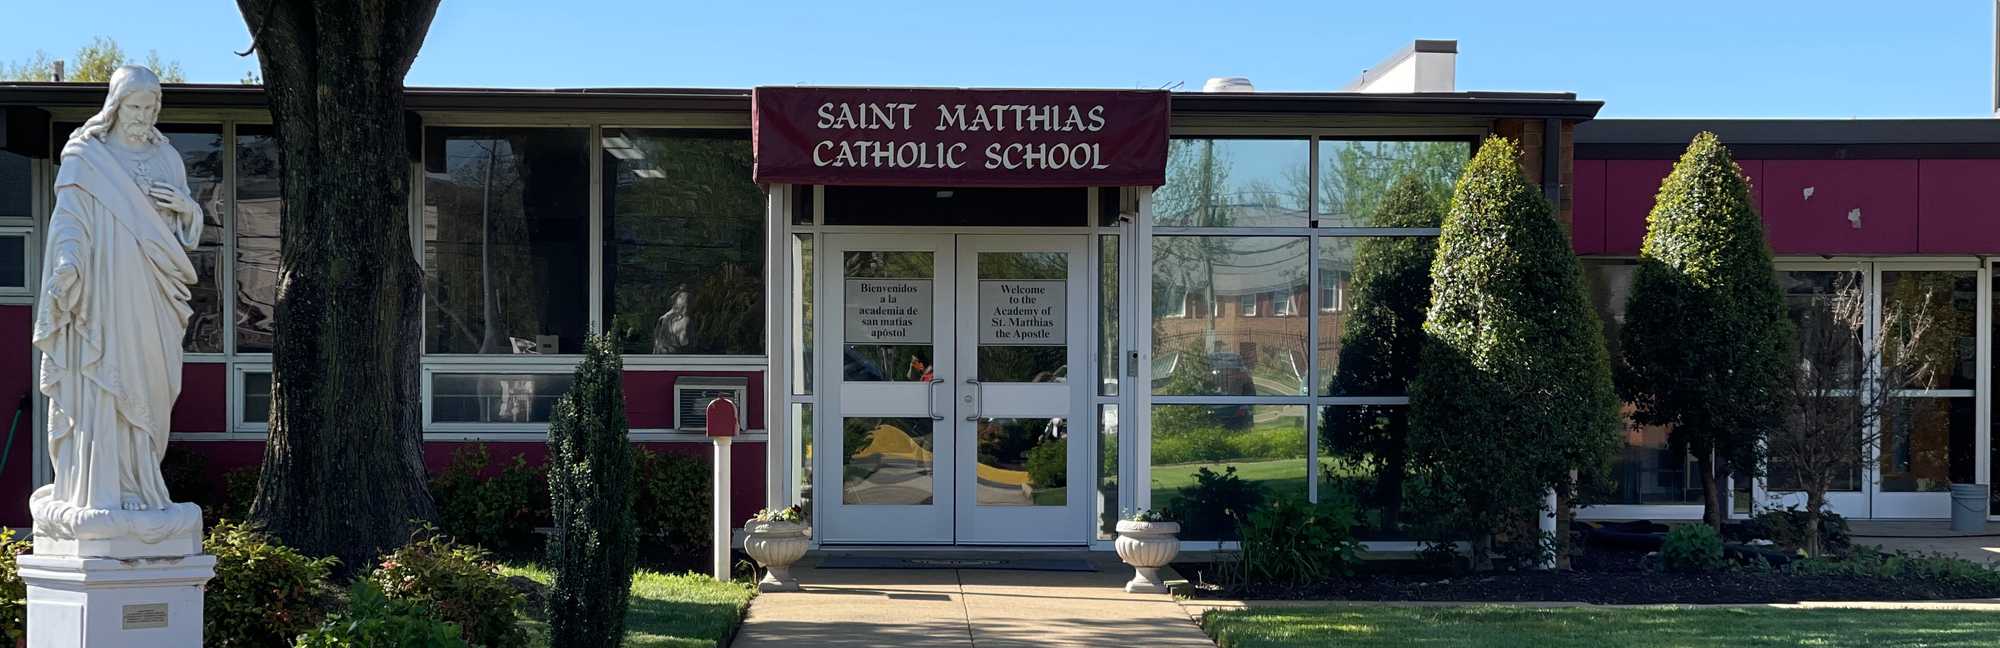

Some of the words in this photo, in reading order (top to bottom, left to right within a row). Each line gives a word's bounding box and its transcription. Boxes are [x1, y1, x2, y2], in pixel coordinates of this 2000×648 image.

[817, 102, 917, 130] SAINT
[935, 103, 1106, 132] MATTHIAS
[813, 140, 967, 169] CATHOLIC
[984, 142, 1111, 170] SCHOOL
[861, 283, 918, 293] Bienvenidos
[1001, 284, 1046, 294] Welcome
[888, 294, 897, 303] la
[1009, 296, 1019, 304] to
[1021, 295, 1037, 304] the
[859, 306, 904, 315] academia
[906, 306, 919, 315] de
[993, 306, 1039, 316] Academy
[1041, 306, 1052, 315] of
[991, 317, 1006, 327] St.
[1008, 316, 1054, 327] Matthias
[995, 329, 1011, 338] the
[1013, 329, 1051, 340] Apostle
